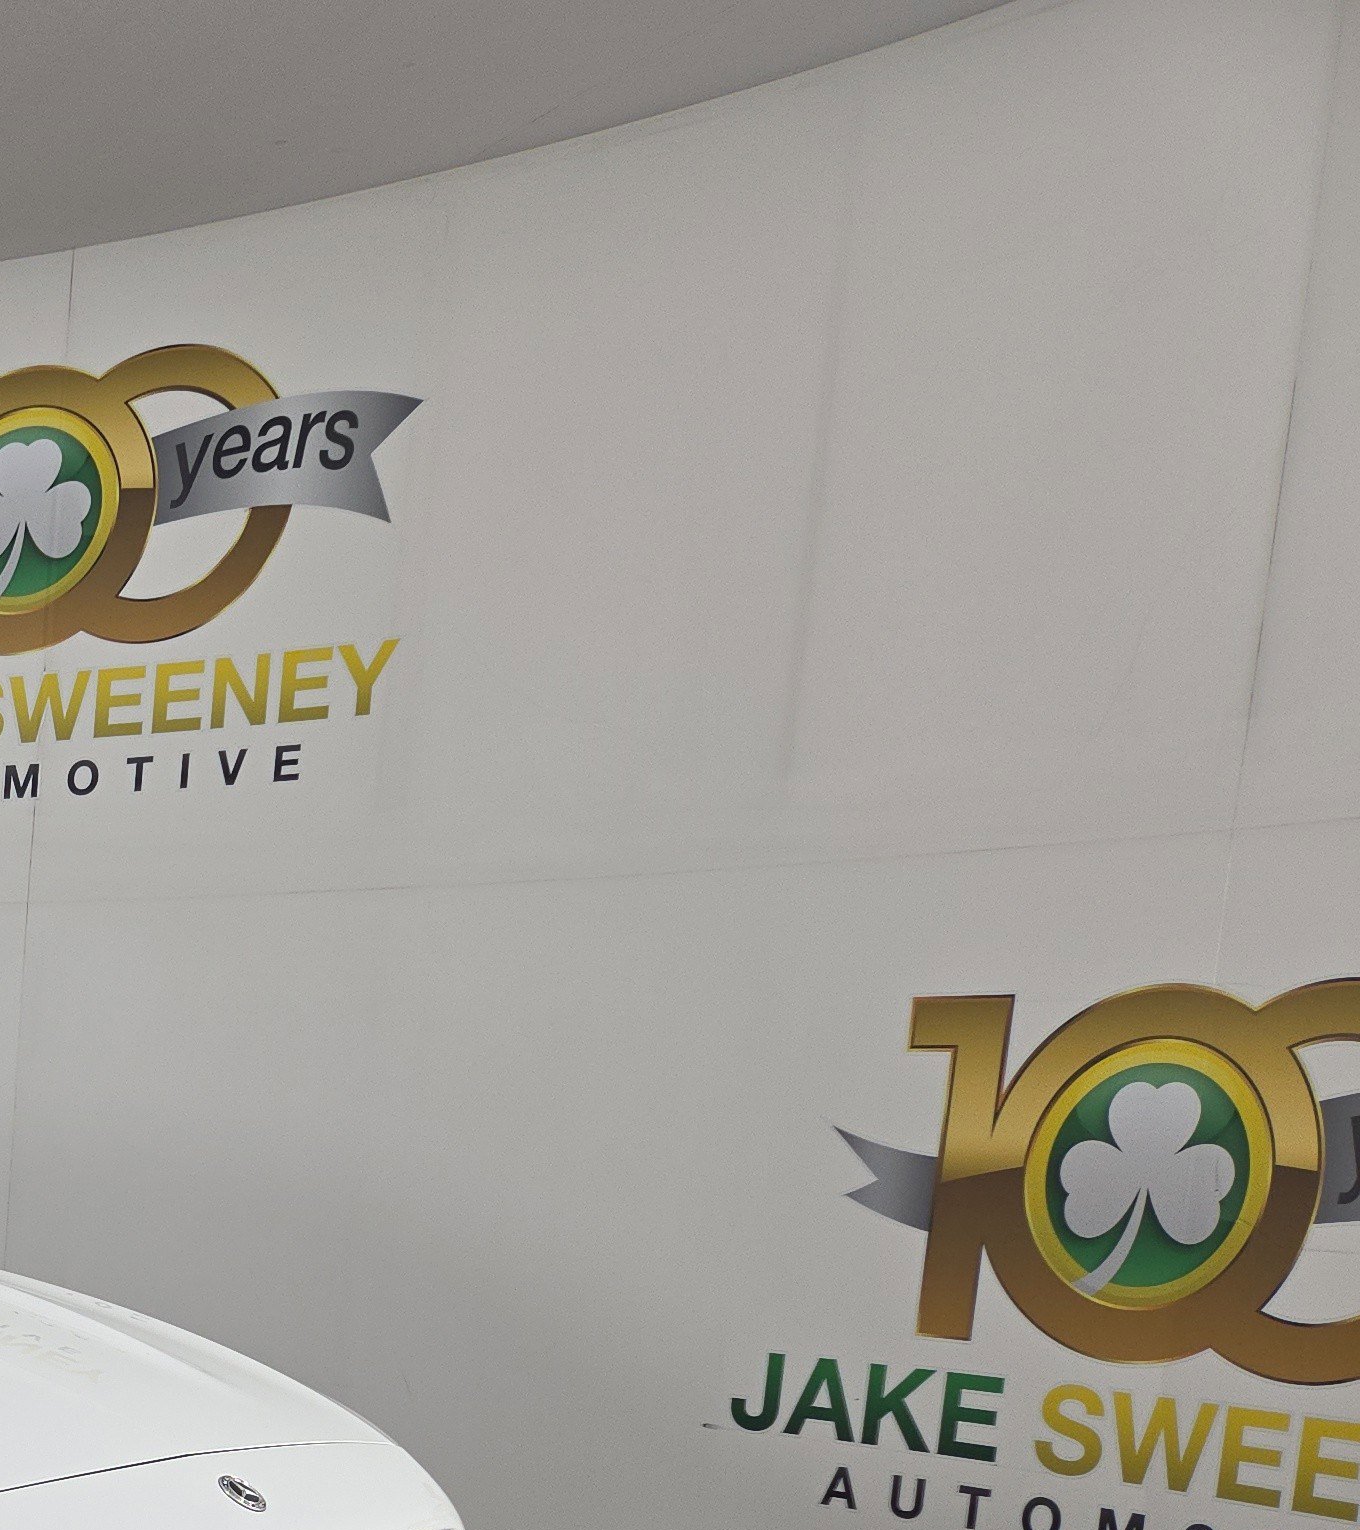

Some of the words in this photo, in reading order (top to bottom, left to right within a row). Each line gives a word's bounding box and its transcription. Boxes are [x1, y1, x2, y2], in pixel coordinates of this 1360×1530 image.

[169, 402, 358, 510] years
[730, 1352, 1005, 1463] JAKE
[1034, 1383, 1360, 1523] SWEE
